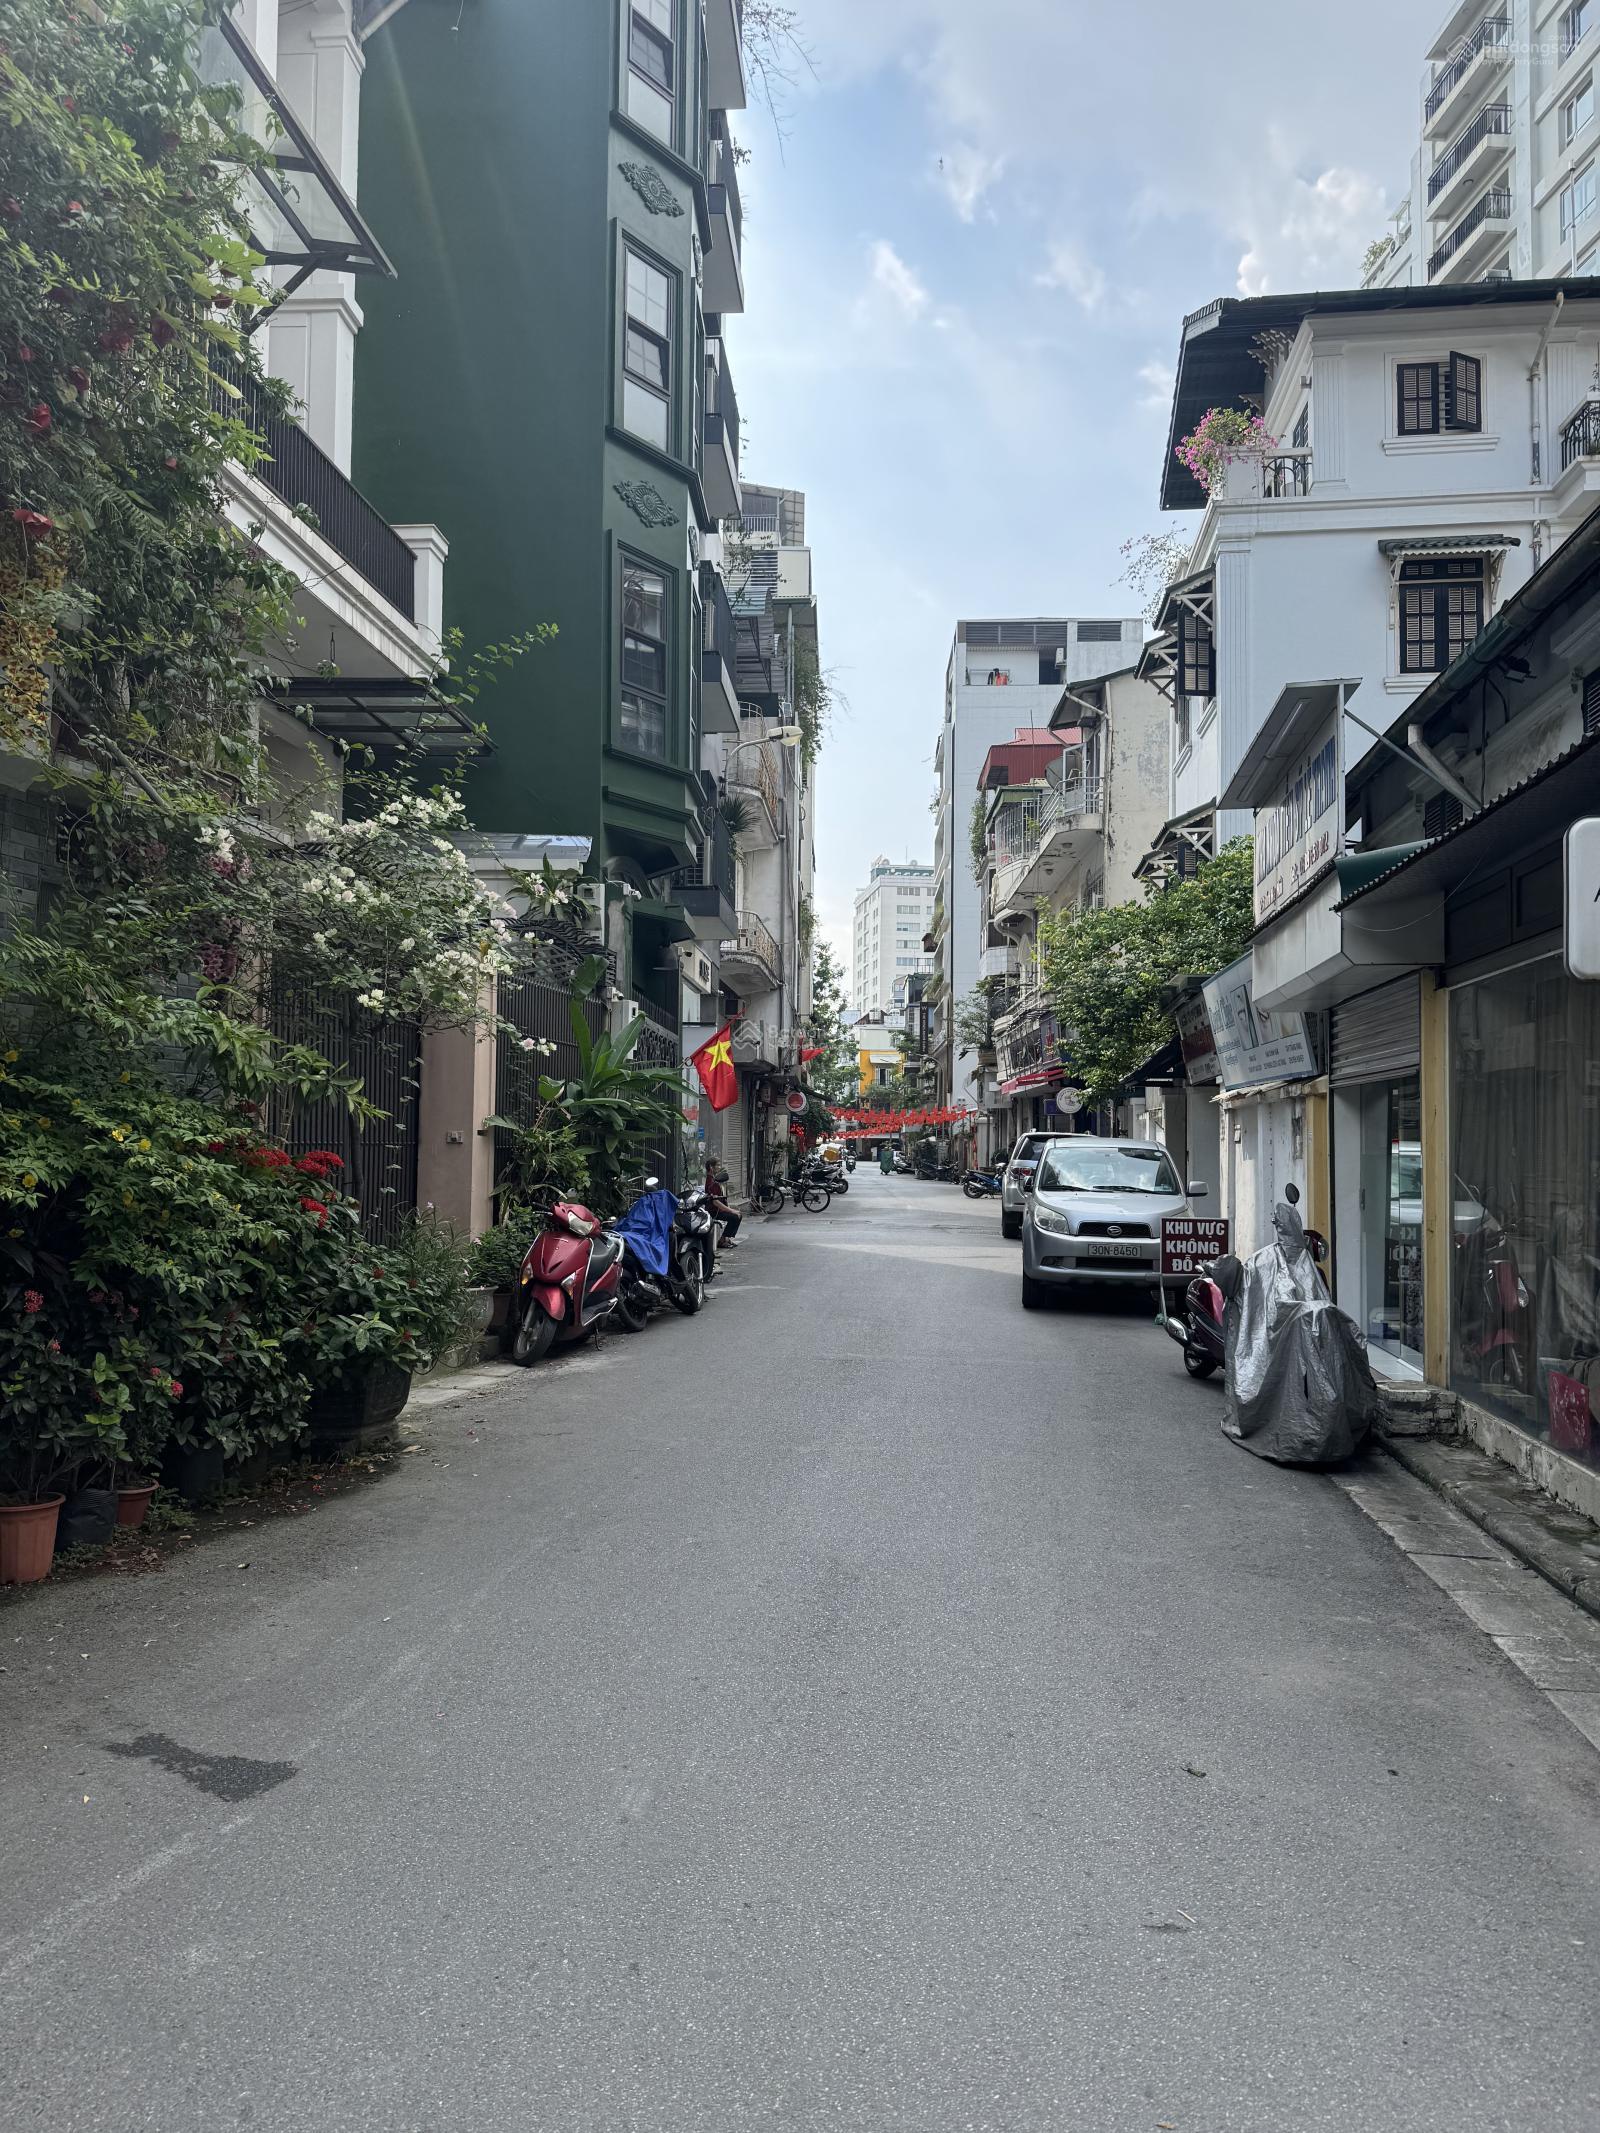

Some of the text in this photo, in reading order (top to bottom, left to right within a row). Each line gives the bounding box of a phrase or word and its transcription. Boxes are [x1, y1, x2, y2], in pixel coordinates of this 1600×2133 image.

[1166, 1220, 1225, 1238] KHU VỰC
[1092, 1245, 1138, 1257] 30N-8450
[1166, 1238, 1220, 1254] KHÔNG
[1172, 1254, 1193, 1271] ĐỖ
